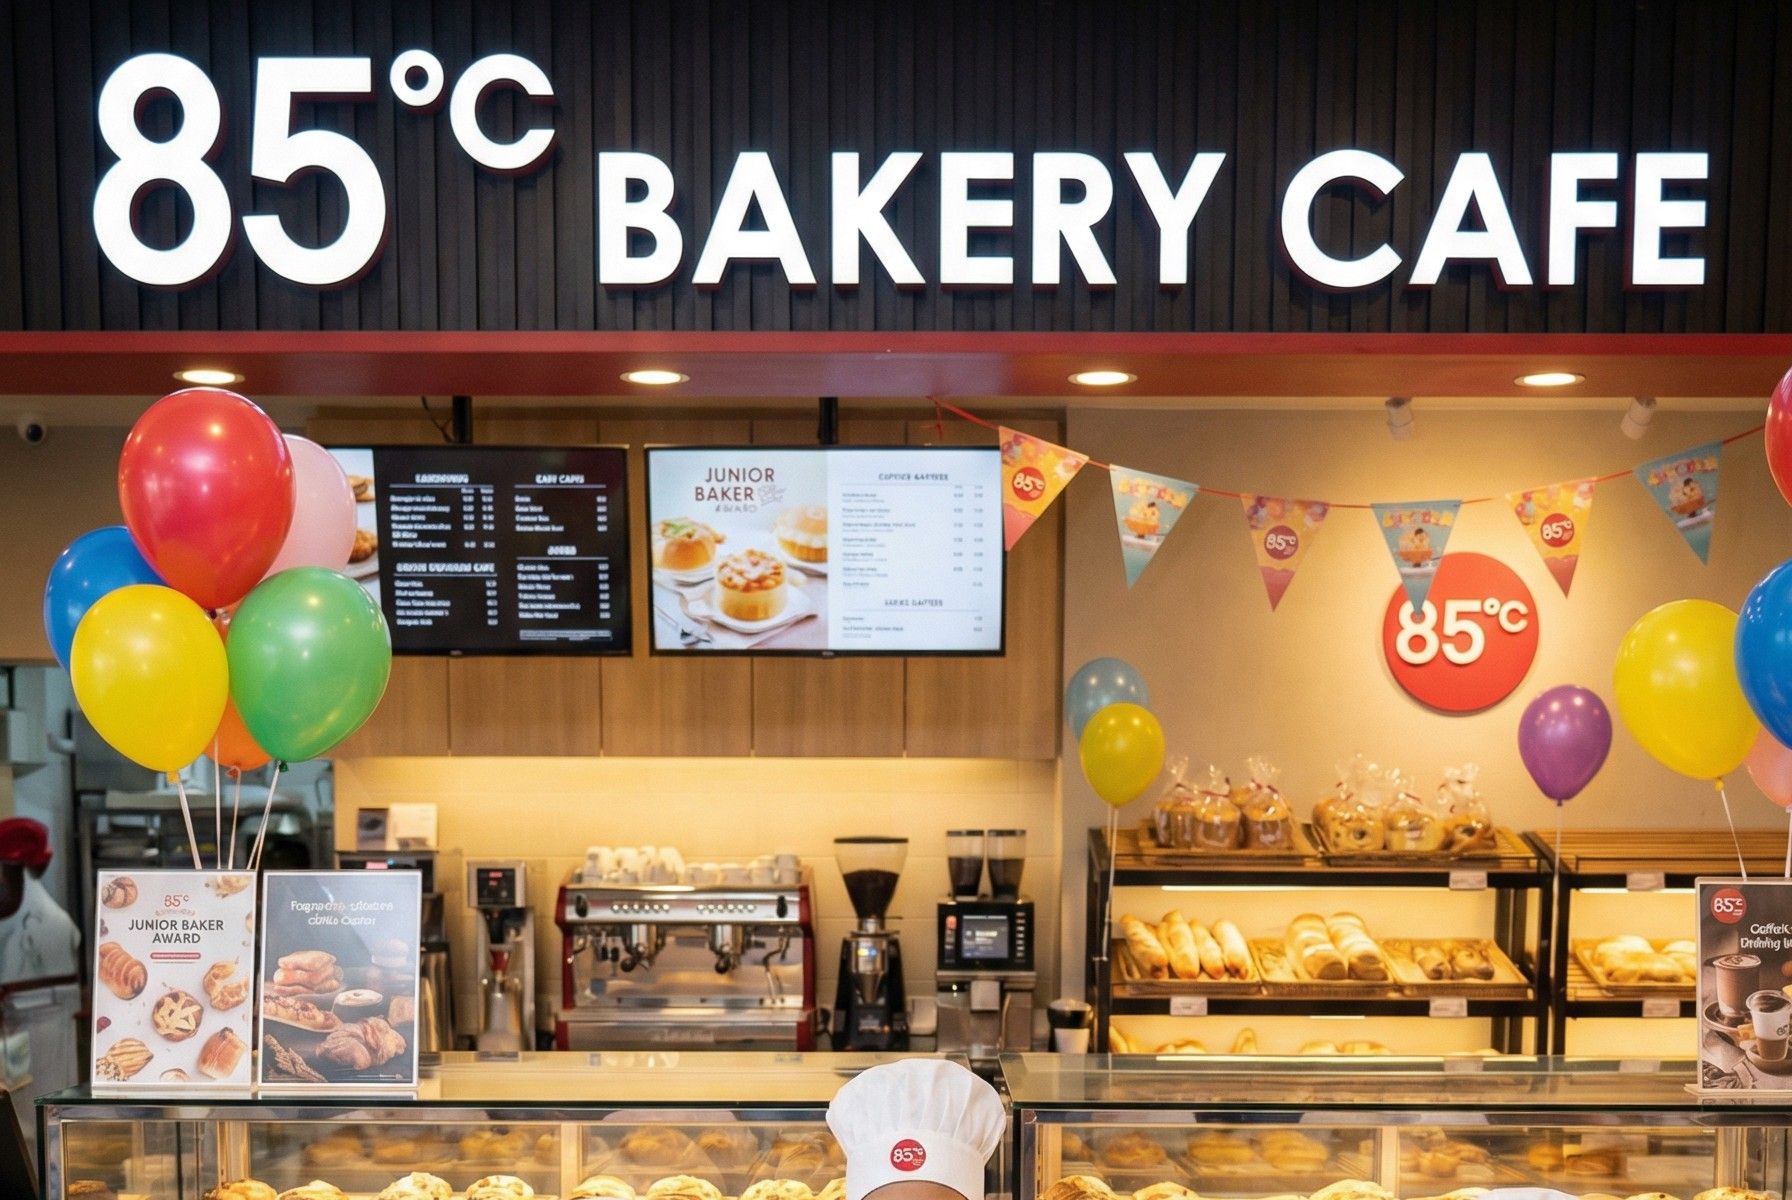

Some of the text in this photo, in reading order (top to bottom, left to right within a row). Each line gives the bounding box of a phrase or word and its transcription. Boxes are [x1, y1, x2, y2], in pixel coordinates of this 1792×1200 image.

[93, 49, 1709, 288] 85°C BAKERY CAFE
[704, 467, 775, 483] JUNIOR
[694, 486, 755, 502] BAKER
[1395, 597, 1529, 665] 85°C
[128, 919, 225, 931] JUNIOR BAKER
[152, 932, 201, 944] AWARD
